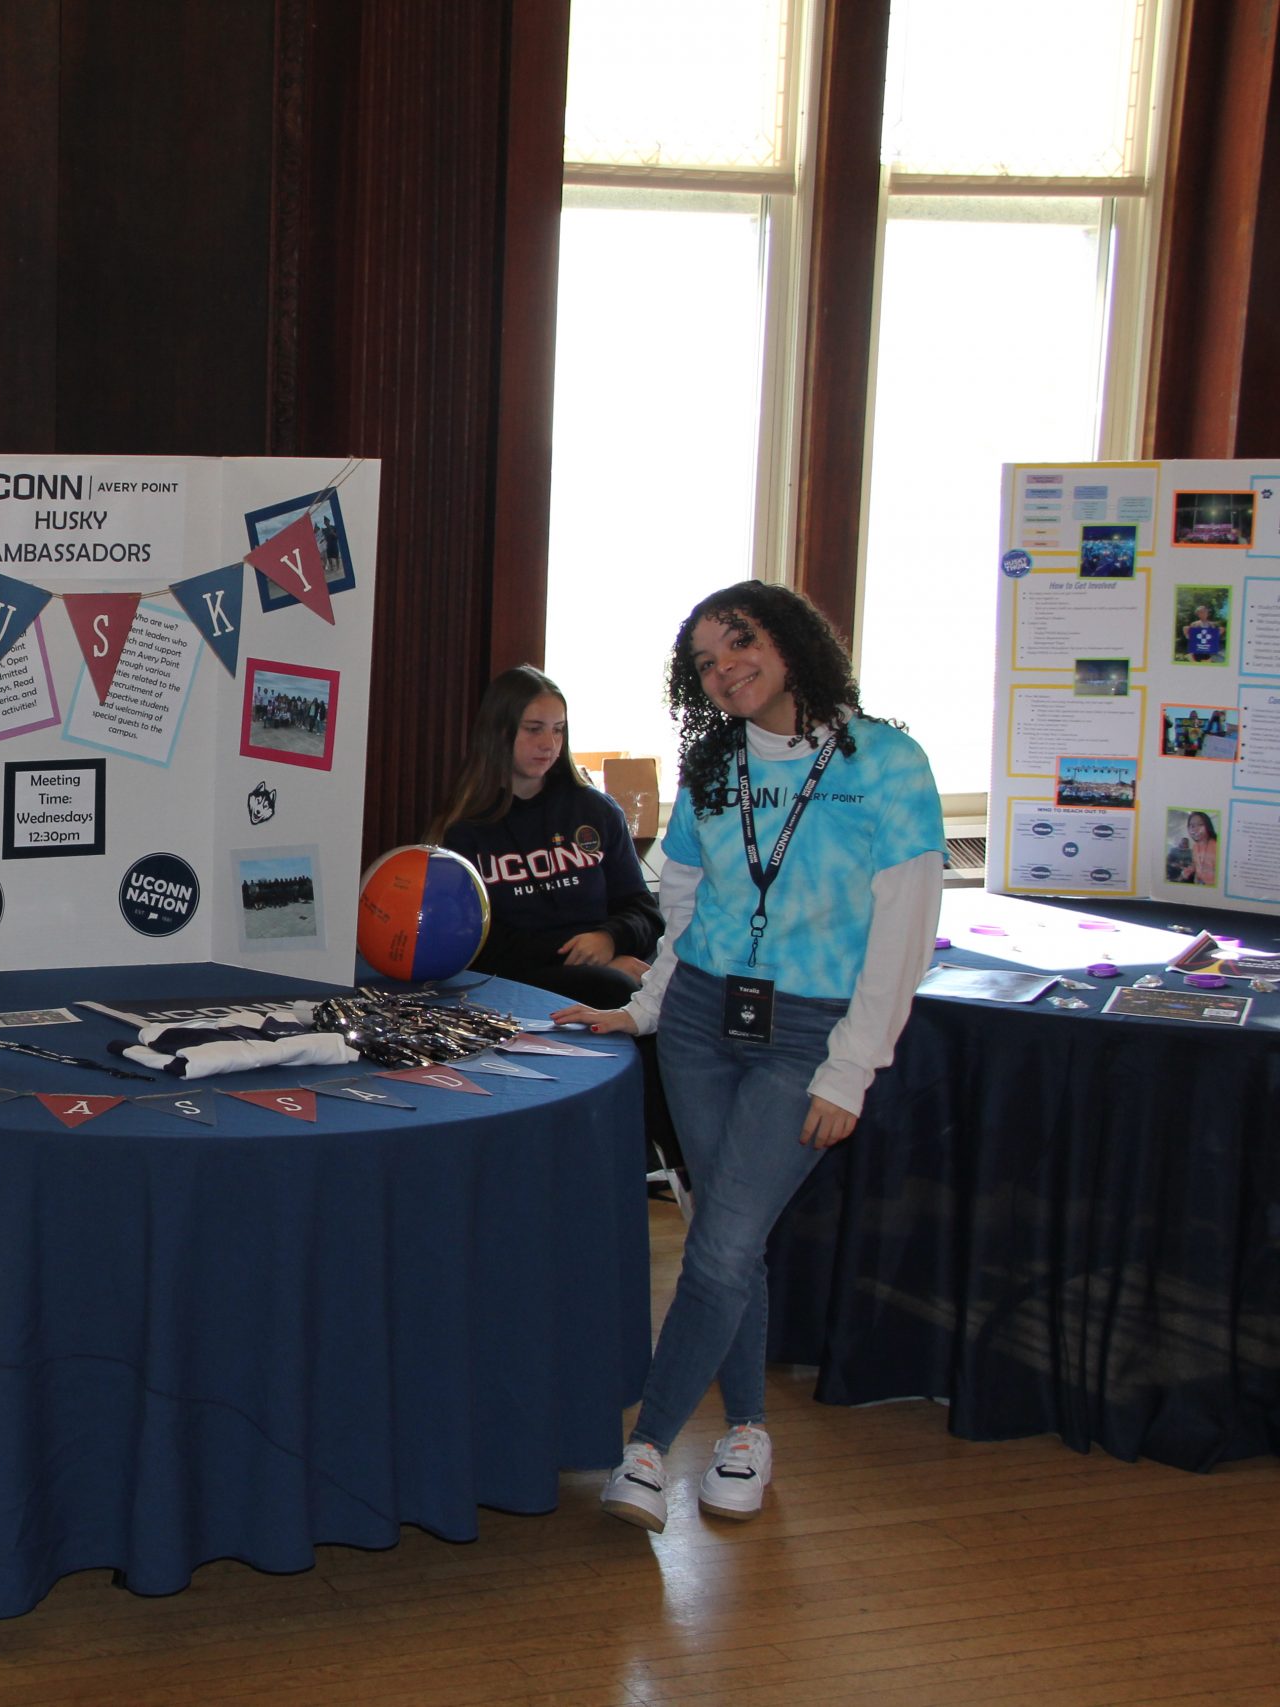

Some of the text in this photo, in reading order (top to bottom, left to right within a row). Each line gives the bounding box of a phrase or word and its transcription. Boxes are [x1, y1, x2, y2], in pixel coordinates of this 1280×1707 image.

[97, 482, 137, 493] AVERY
[141, 482, 179, 493] POINT
[34, 511, 108, 530] HUSKY
[1049, 582, 1064, 590] How
[1074, 582, 1087, 590] Get
[1089, 582, 1117, 590] Involved
[150, 618, 162, 627] are
[164, 623, 178, 631] we?
[145, 628, 170, 643] leaders
[171, 638, 188, 648] who
[138, 639, 154, 650] and
[154, 645, 182, 658] support
[6, 655, 28, 667] Open
[138, 651, 160, 663] Avery
[160, 657, 180, 669] Point
[145, 666, 171, 678] various
[13, 676, 35, 689] Read
[112, 681, 163, 699] recruitment of
[131, 672, 158, 686] related
[159, 681, 167, 689] to
[168, 682, 181, 692] the
[21, 688, 38, 698] and
[1, 699, 37, 715] activities!
[115, 704, 153, 721] welcoming
[154, 714, 163, 722] of
[140, 698, 169, 712] students
[92, 710, 163, 734] special guests to the
[30, 774, 81, 787] Meeting
[38, 793, 72, 805] Time:
[740, 775, 751, 811] UCONN
[832, 794, 864, 804] POINT
[17, 811, 93, 824] Wednesdays
[28, 830, 80, 843] 12:30pm
[770, 829, 791, 866] UCONN
[131, 872, 193, 900] UCONN
[514, 876, 580, 896] HUKIES
[126, 887, 189, 914] NATION
